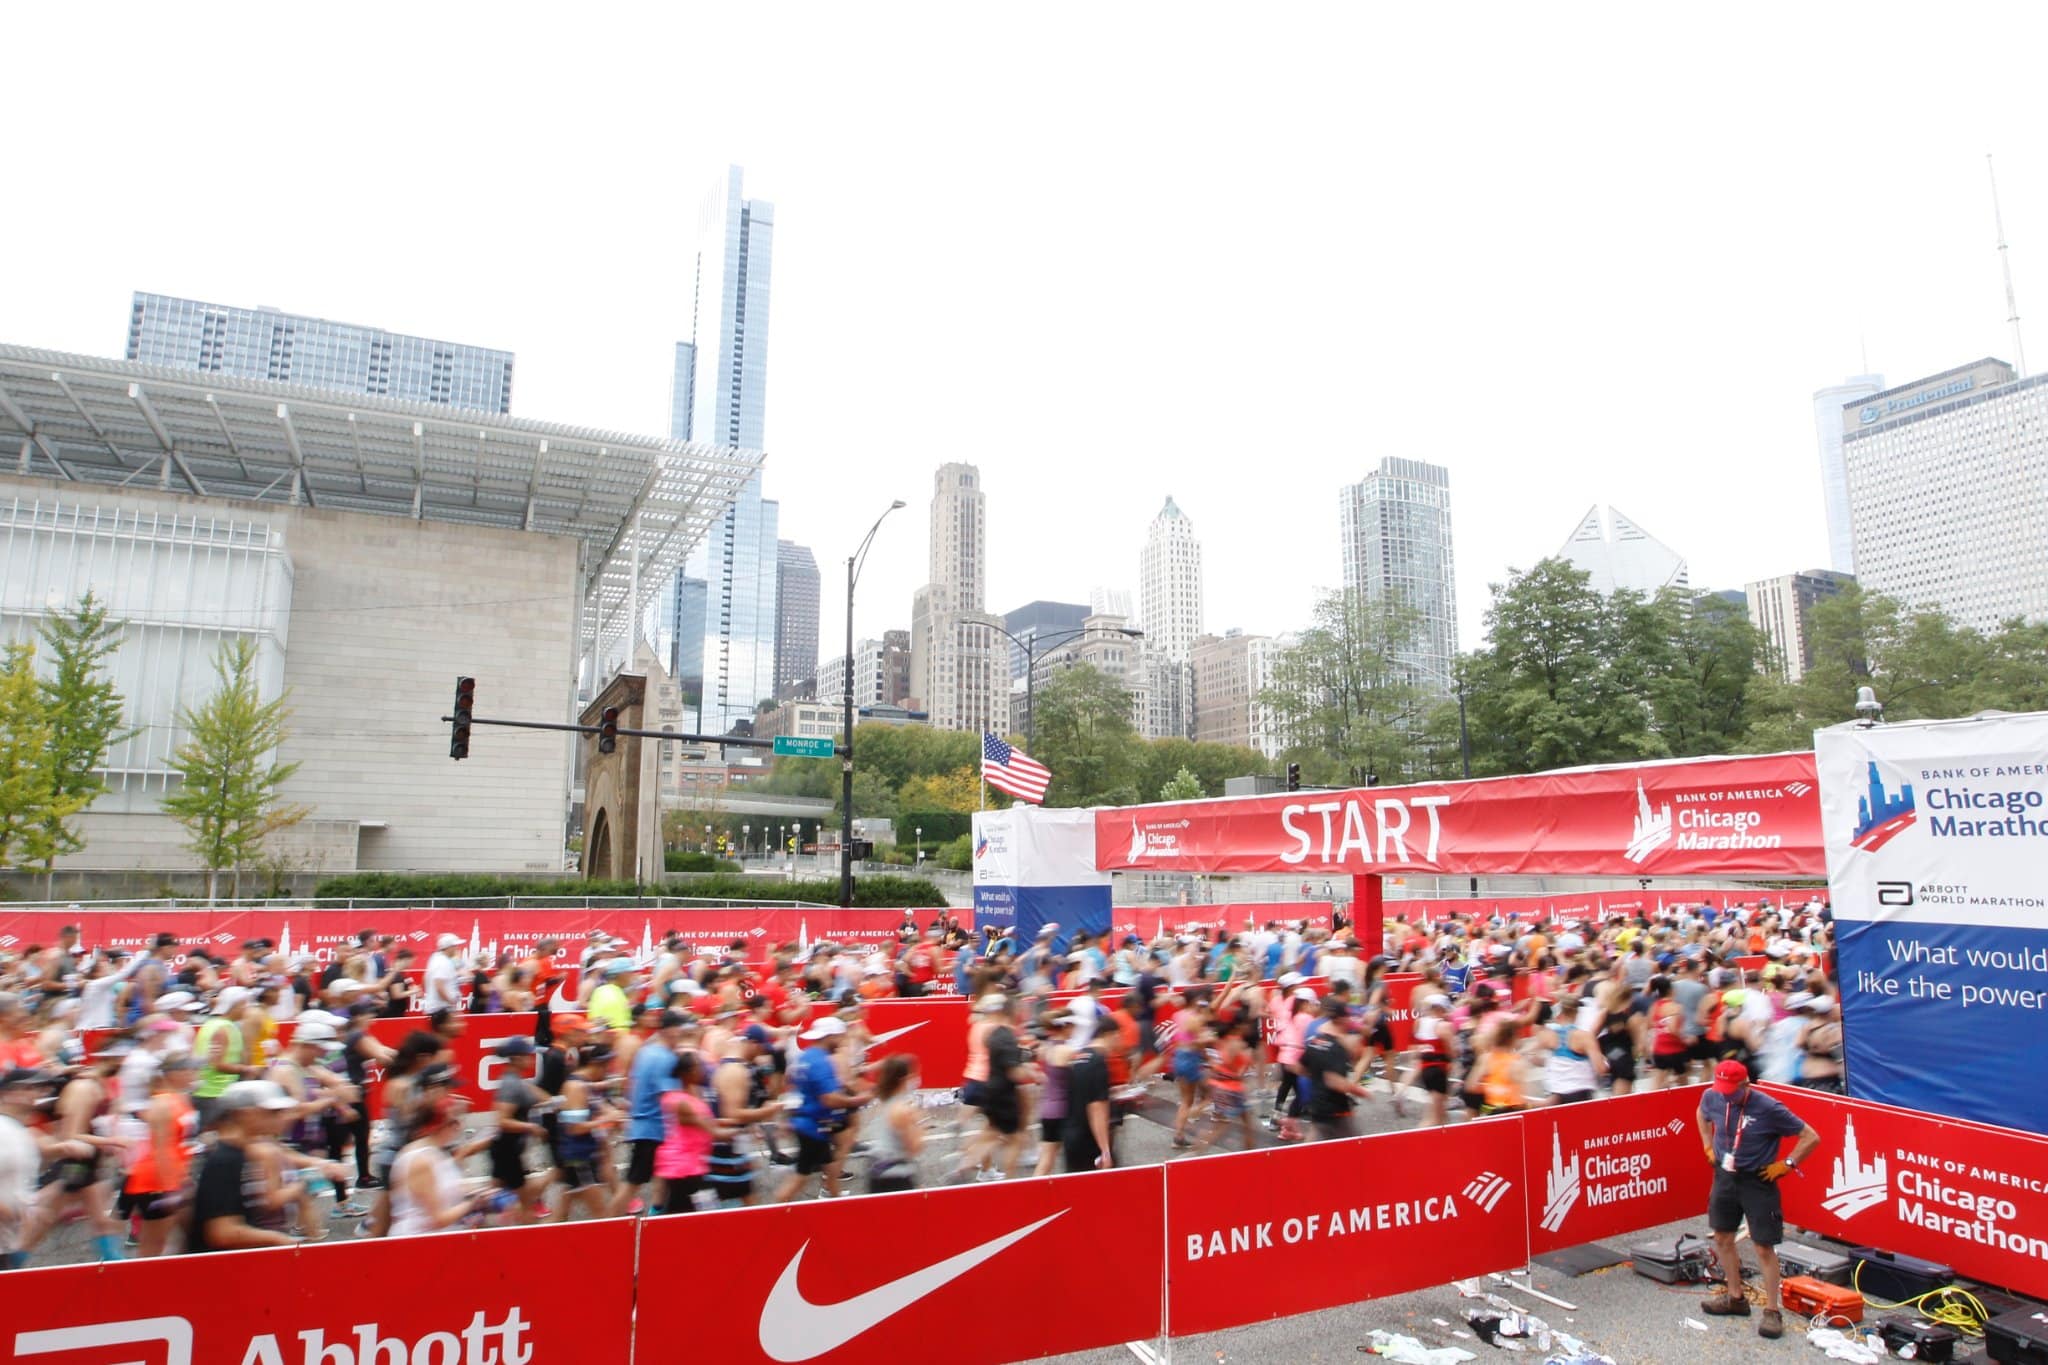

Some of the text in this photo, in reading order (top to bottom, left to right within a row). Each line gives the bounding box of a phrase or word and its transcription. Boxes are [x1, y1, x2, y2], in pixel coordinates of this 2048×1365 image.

[786, 739, 820, 749] MONROE
[1921, 769, 1965, 779] BANK
[1970, 768, 1990, 778] OF
[1676, 789, 1784, 803] BANK OF AMERICA
[1926, 788, 2043, 814] Chicago
[1280, 796, 1450, 864] START
[1678, 809, 1761, 832] Chicago
[1147, 832, 1176, 847] Chicago
[1676, 832, 1781, 850] Marathon
[1920, 885, 1968, 894] ABBOTT
[1920, 895, 2044, 907] WORLD MARATHON
[111, 938, 142, 946] BANK
[316, 935, 345, 943] BANK
[860, 929, 895, 937] AMERICA
[1887, 939, 2048, 972] What would
[1858, 970, 2047, 1009] like the power
[1584, 1127, 1667, 1150] BANK OF AMERICA
[1585, 1153, 1652, 1180] Chicago
[1896, 1149, 1940, 1169] BANK
[1943, 1161, 1966, 1175] OF
[1586, 1175, 1667, 1208] Marathon
[1897, 1170, 2017, 1221] Chicago
[1187, 1195, 1458, 1261] BANK OF AMERICA
[1898, 1197, 2048, 1260] Marathon
